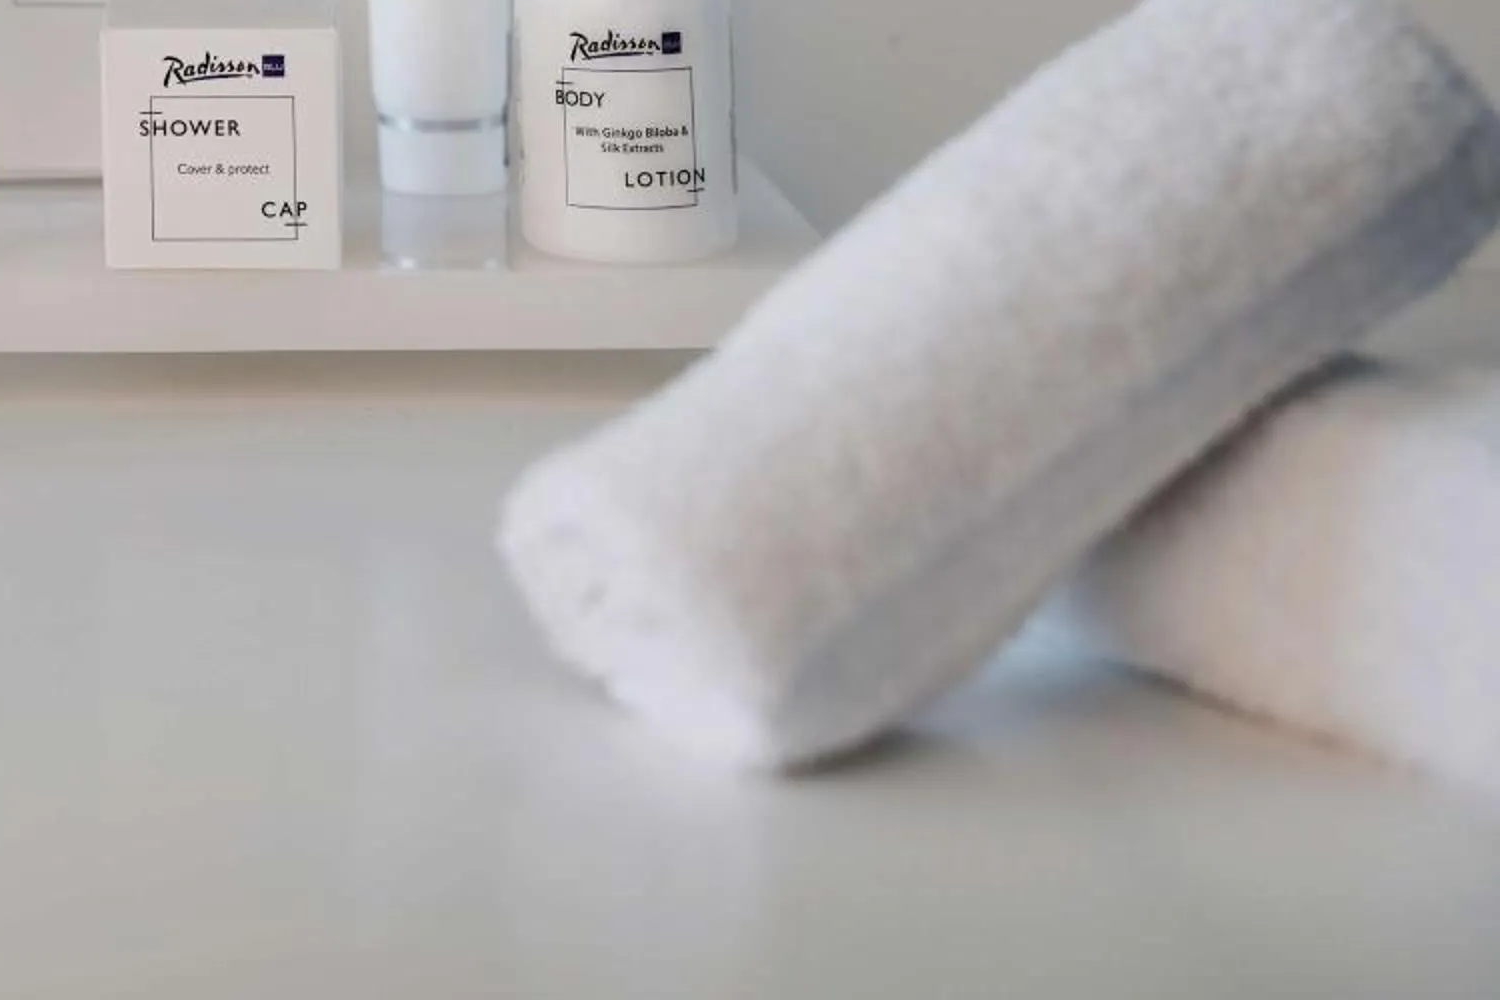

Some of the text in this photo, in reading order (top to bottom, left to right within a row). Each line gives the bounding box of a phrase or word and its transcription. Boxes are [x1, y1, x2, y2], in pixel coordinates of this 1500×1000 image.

[569, 28, 660, 62] Radisson
[164, 51, 260, 88] Radisson
[555, 89, 605, 108] BODY
[139, 118, 241, 138] SHOWER
[601, 126, 642, 141] Ginkgo
[177, 162, 270, 179] Cover & protect
[624, 168, 705, 188] LOTION
[260, 200, 307, 219] CAP
